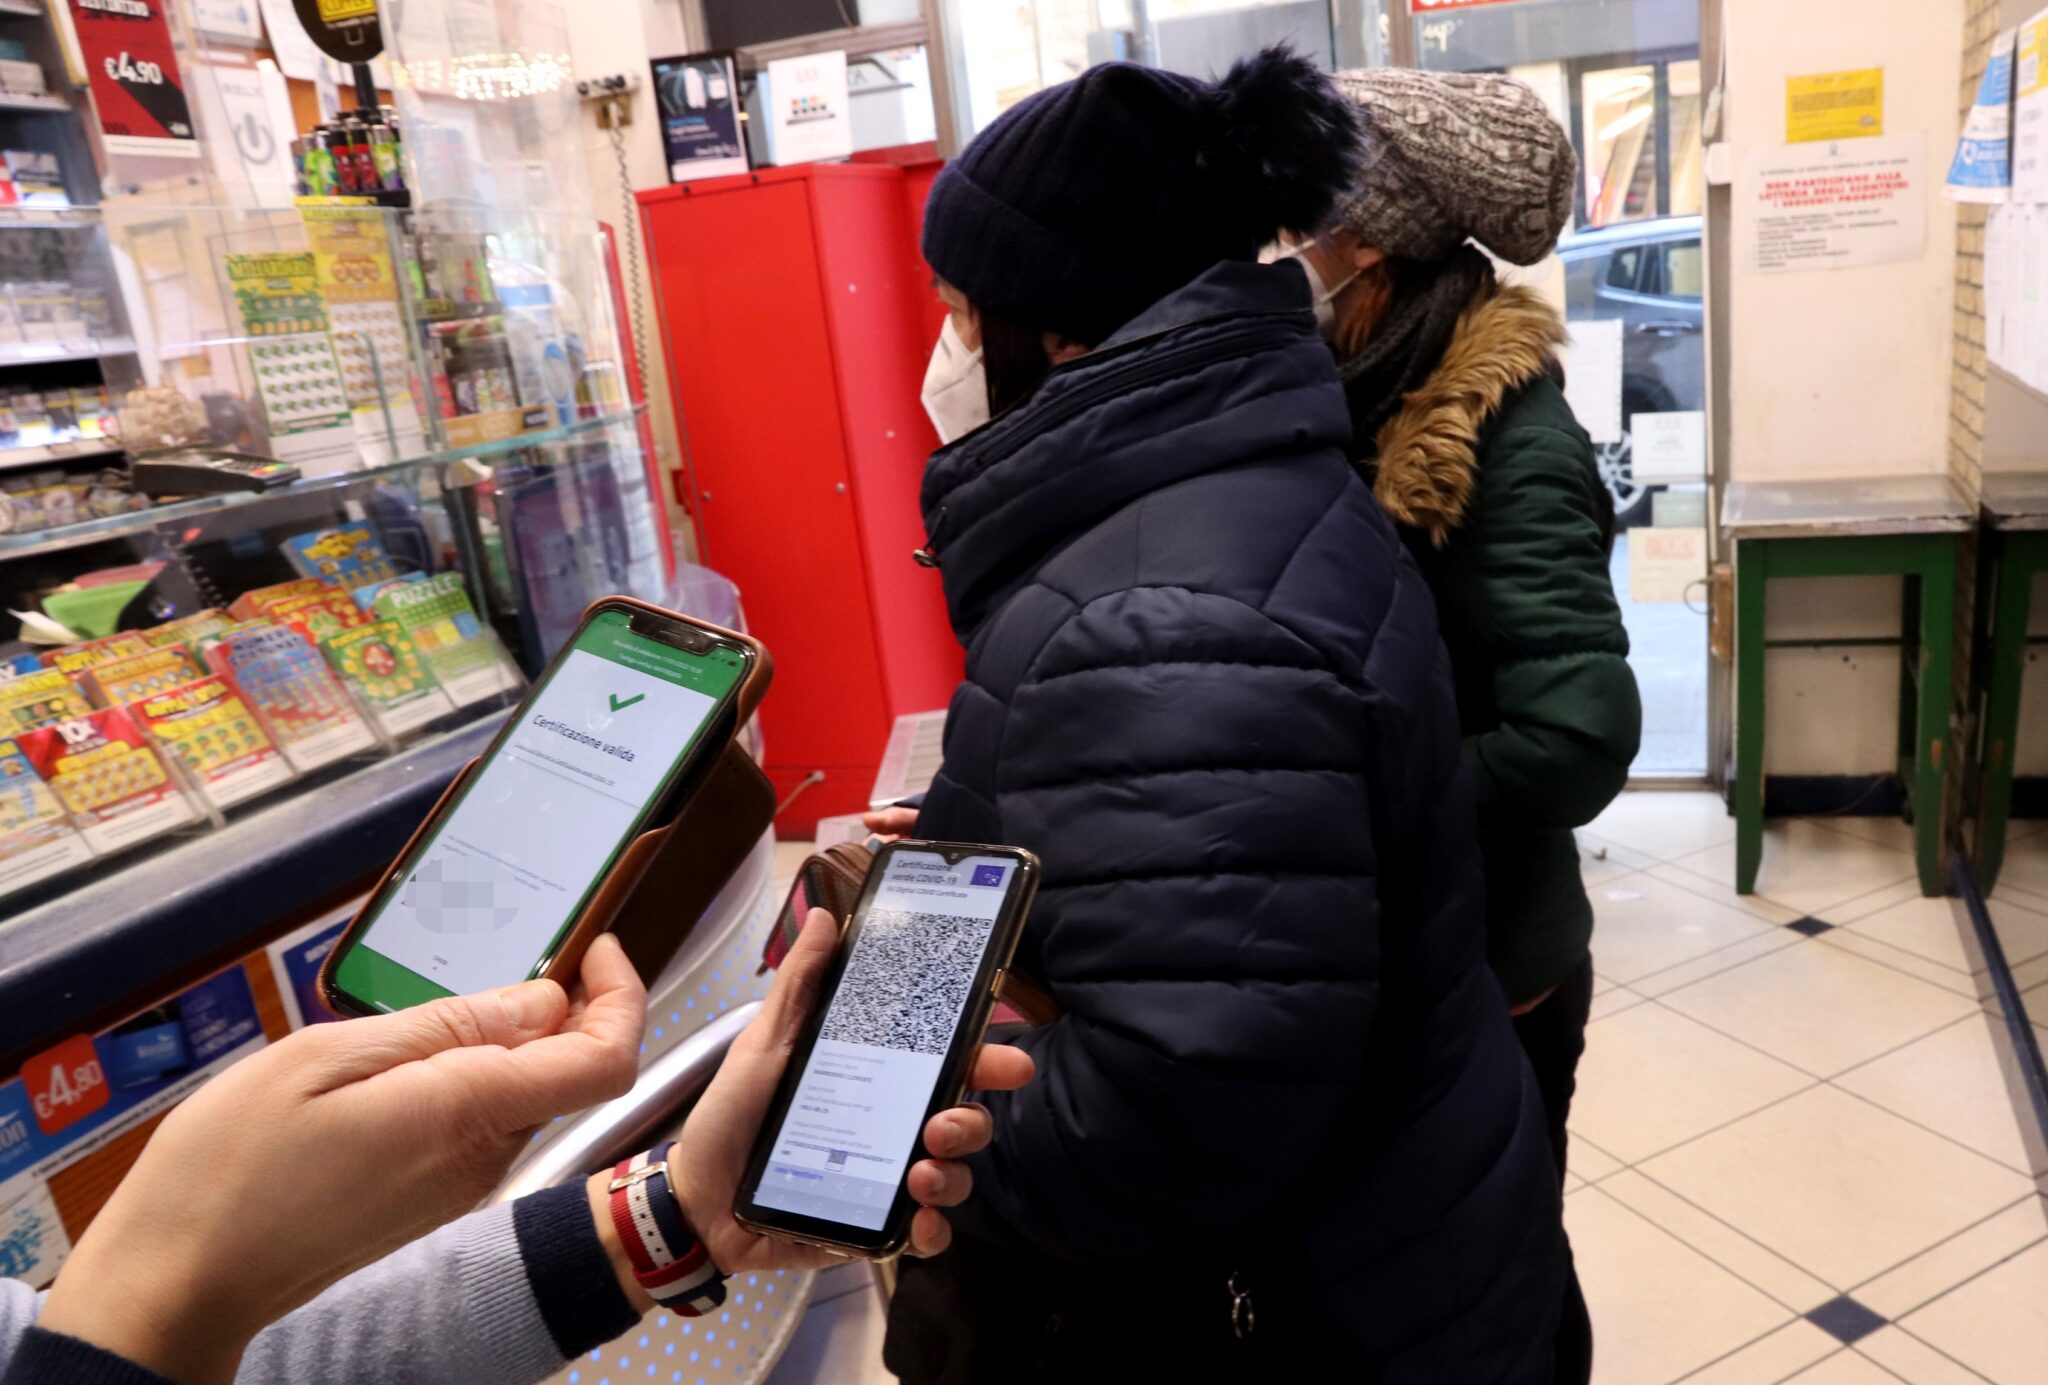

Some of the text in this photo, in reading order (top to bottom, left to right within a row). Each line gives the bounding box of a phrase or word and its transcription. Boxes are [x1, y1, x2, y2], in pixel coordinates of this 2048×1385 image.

[1759, 180, 1909, 201] LOTTERIA DEGLI SCONTRINI
[1765, 171, 1903, 190] NON PARTECIPANO ALLA
[1782, 197, 1834, 208] SEGUENTI
[1838, 191, 1894, 203] PRODOTTI
[390, 575, 456, 608] PUZZLE
[533, 714, 636, 763] Certificazione valida
[891, 872, 957, 885] verde COVID-19
